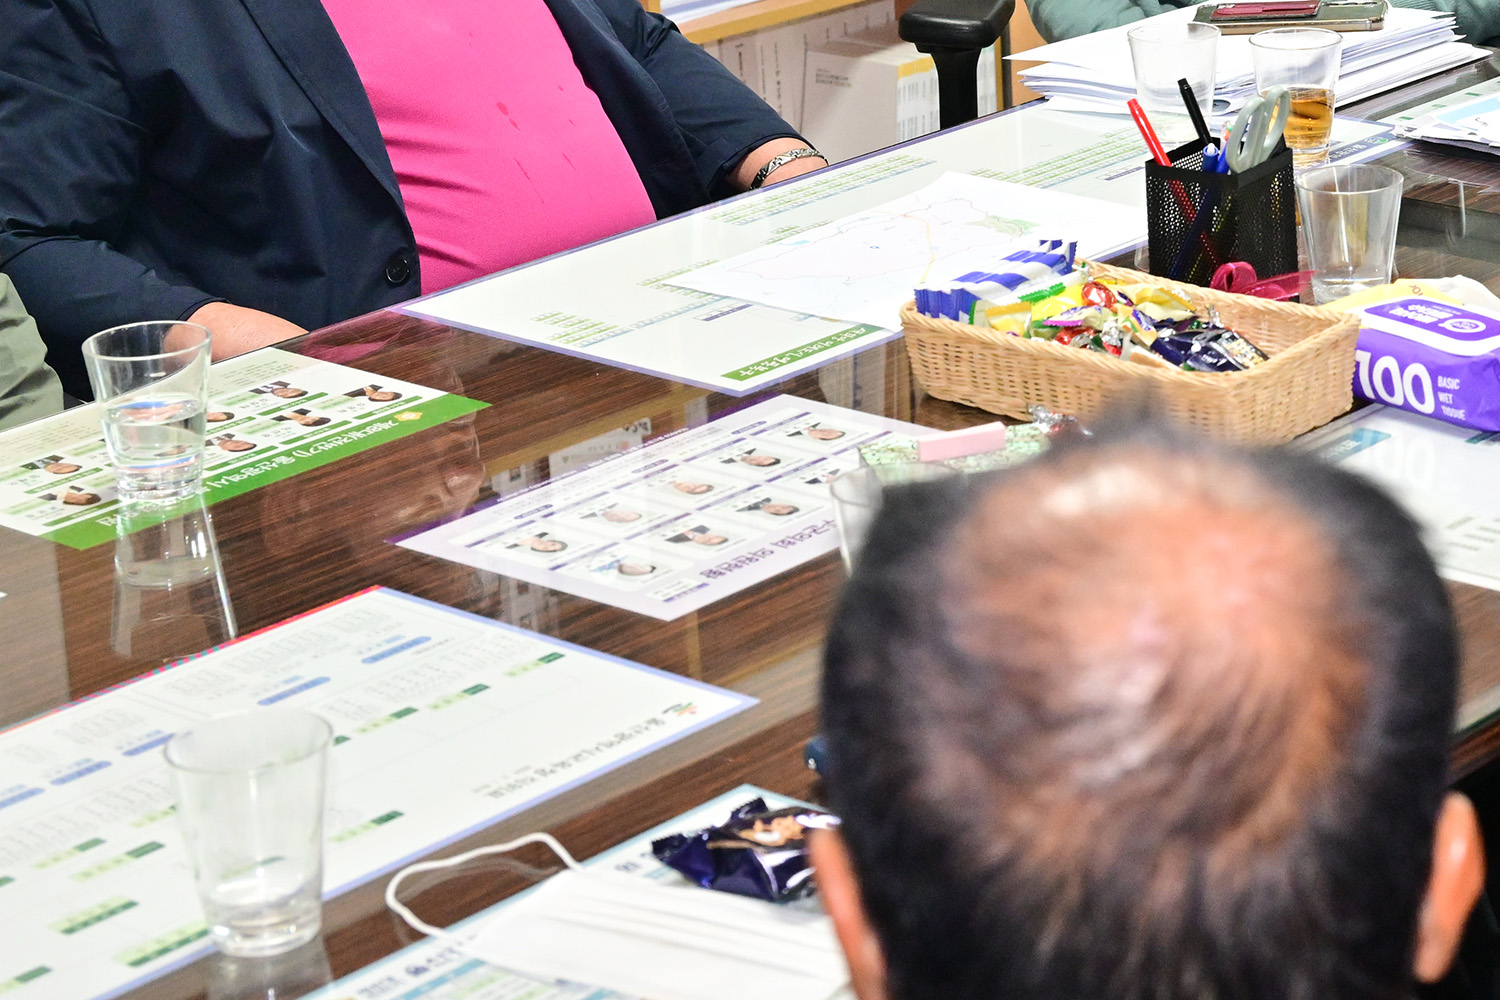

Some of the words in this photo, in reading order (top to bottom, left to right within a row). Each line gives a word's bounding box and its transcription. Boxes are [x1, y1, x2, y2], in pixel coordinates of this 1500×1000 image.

[1355, 350, 1436, 416] 100
[1437, 375, 1460, 391] BASIC
[1438, 392, 1454, 405] WET
[294, 418, 399, 462] 제8대(전반기)
